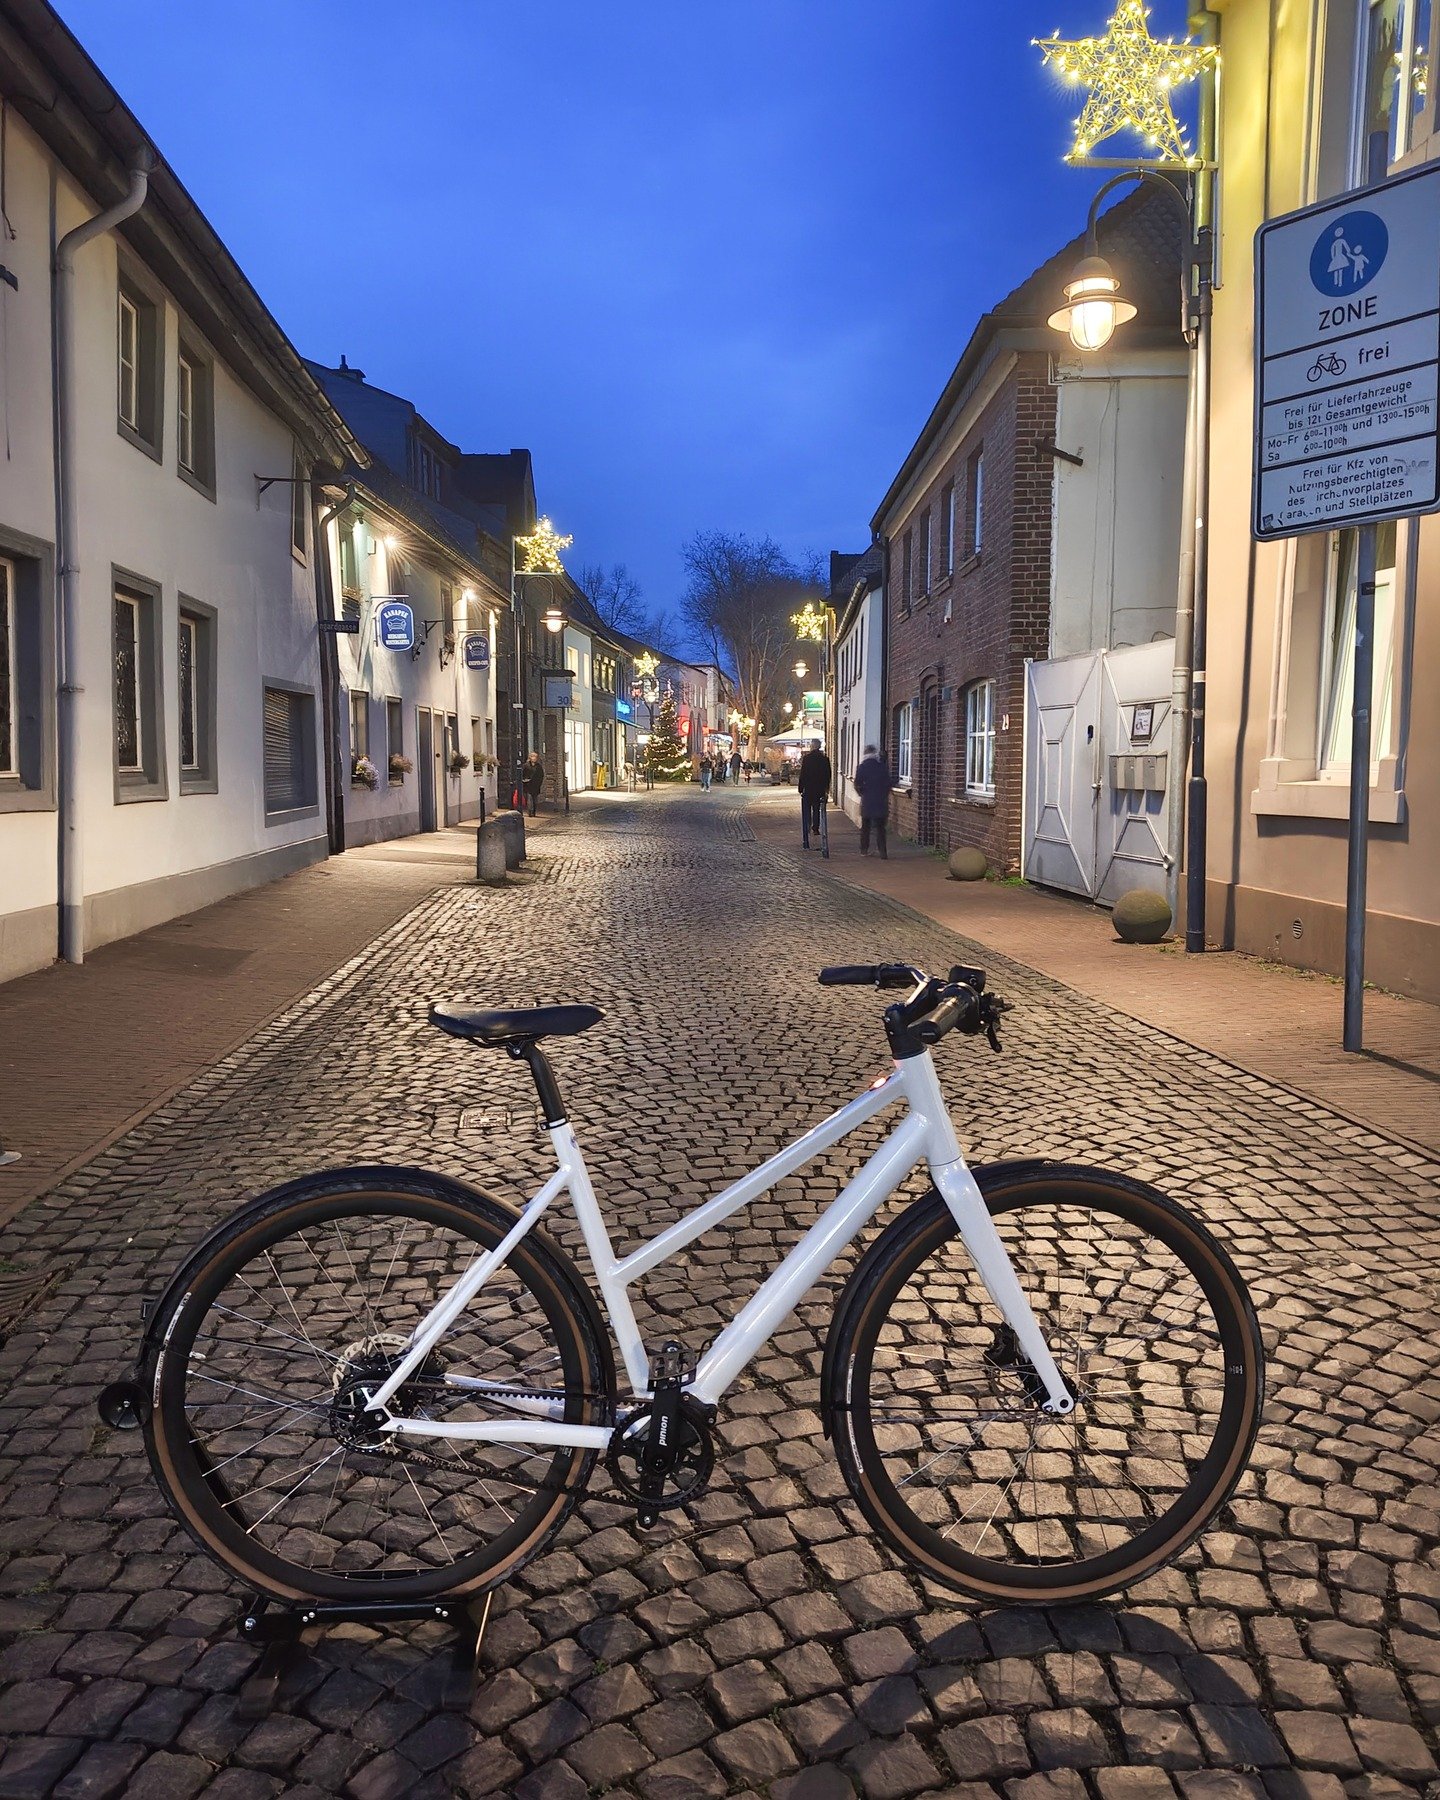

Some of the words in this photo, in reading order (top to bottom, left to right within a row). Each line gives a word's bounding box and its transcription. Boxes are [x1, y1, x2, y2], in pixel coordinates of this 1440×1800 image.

[1318, 295, 1378, 331] ZONE
[1358, 341, 1390, 365] frei
[1284, 405, 1304, 418] Frei
[1308, 401, 1323, 415] für
[1327, 381, 1413, 408] Lieferfahrzeuge
[1288, 418, 1303, 430] bis
[1325, 393, 1407, 421] Gesamtgewicht
[1267, 434, 1299, 449] Mo-Fr
[1352, 417, 1372, 431] und
[1267, 451, 1280, 462] Sa
[1303, 466, 1323, 480] Frei
[1327, 463, 1342, 475] für
[1347, 459, 1364, 471] Kfz
[1369, 455, 1388, 466] von
[1287, 496, 1305, 507] des
[1325, 501, 1344, 512] und
[1349, 489, 1413, 508] Stellplätzen
[557, 696, 569, 705] 30
[658, 1415, 669, 1447] pinion
